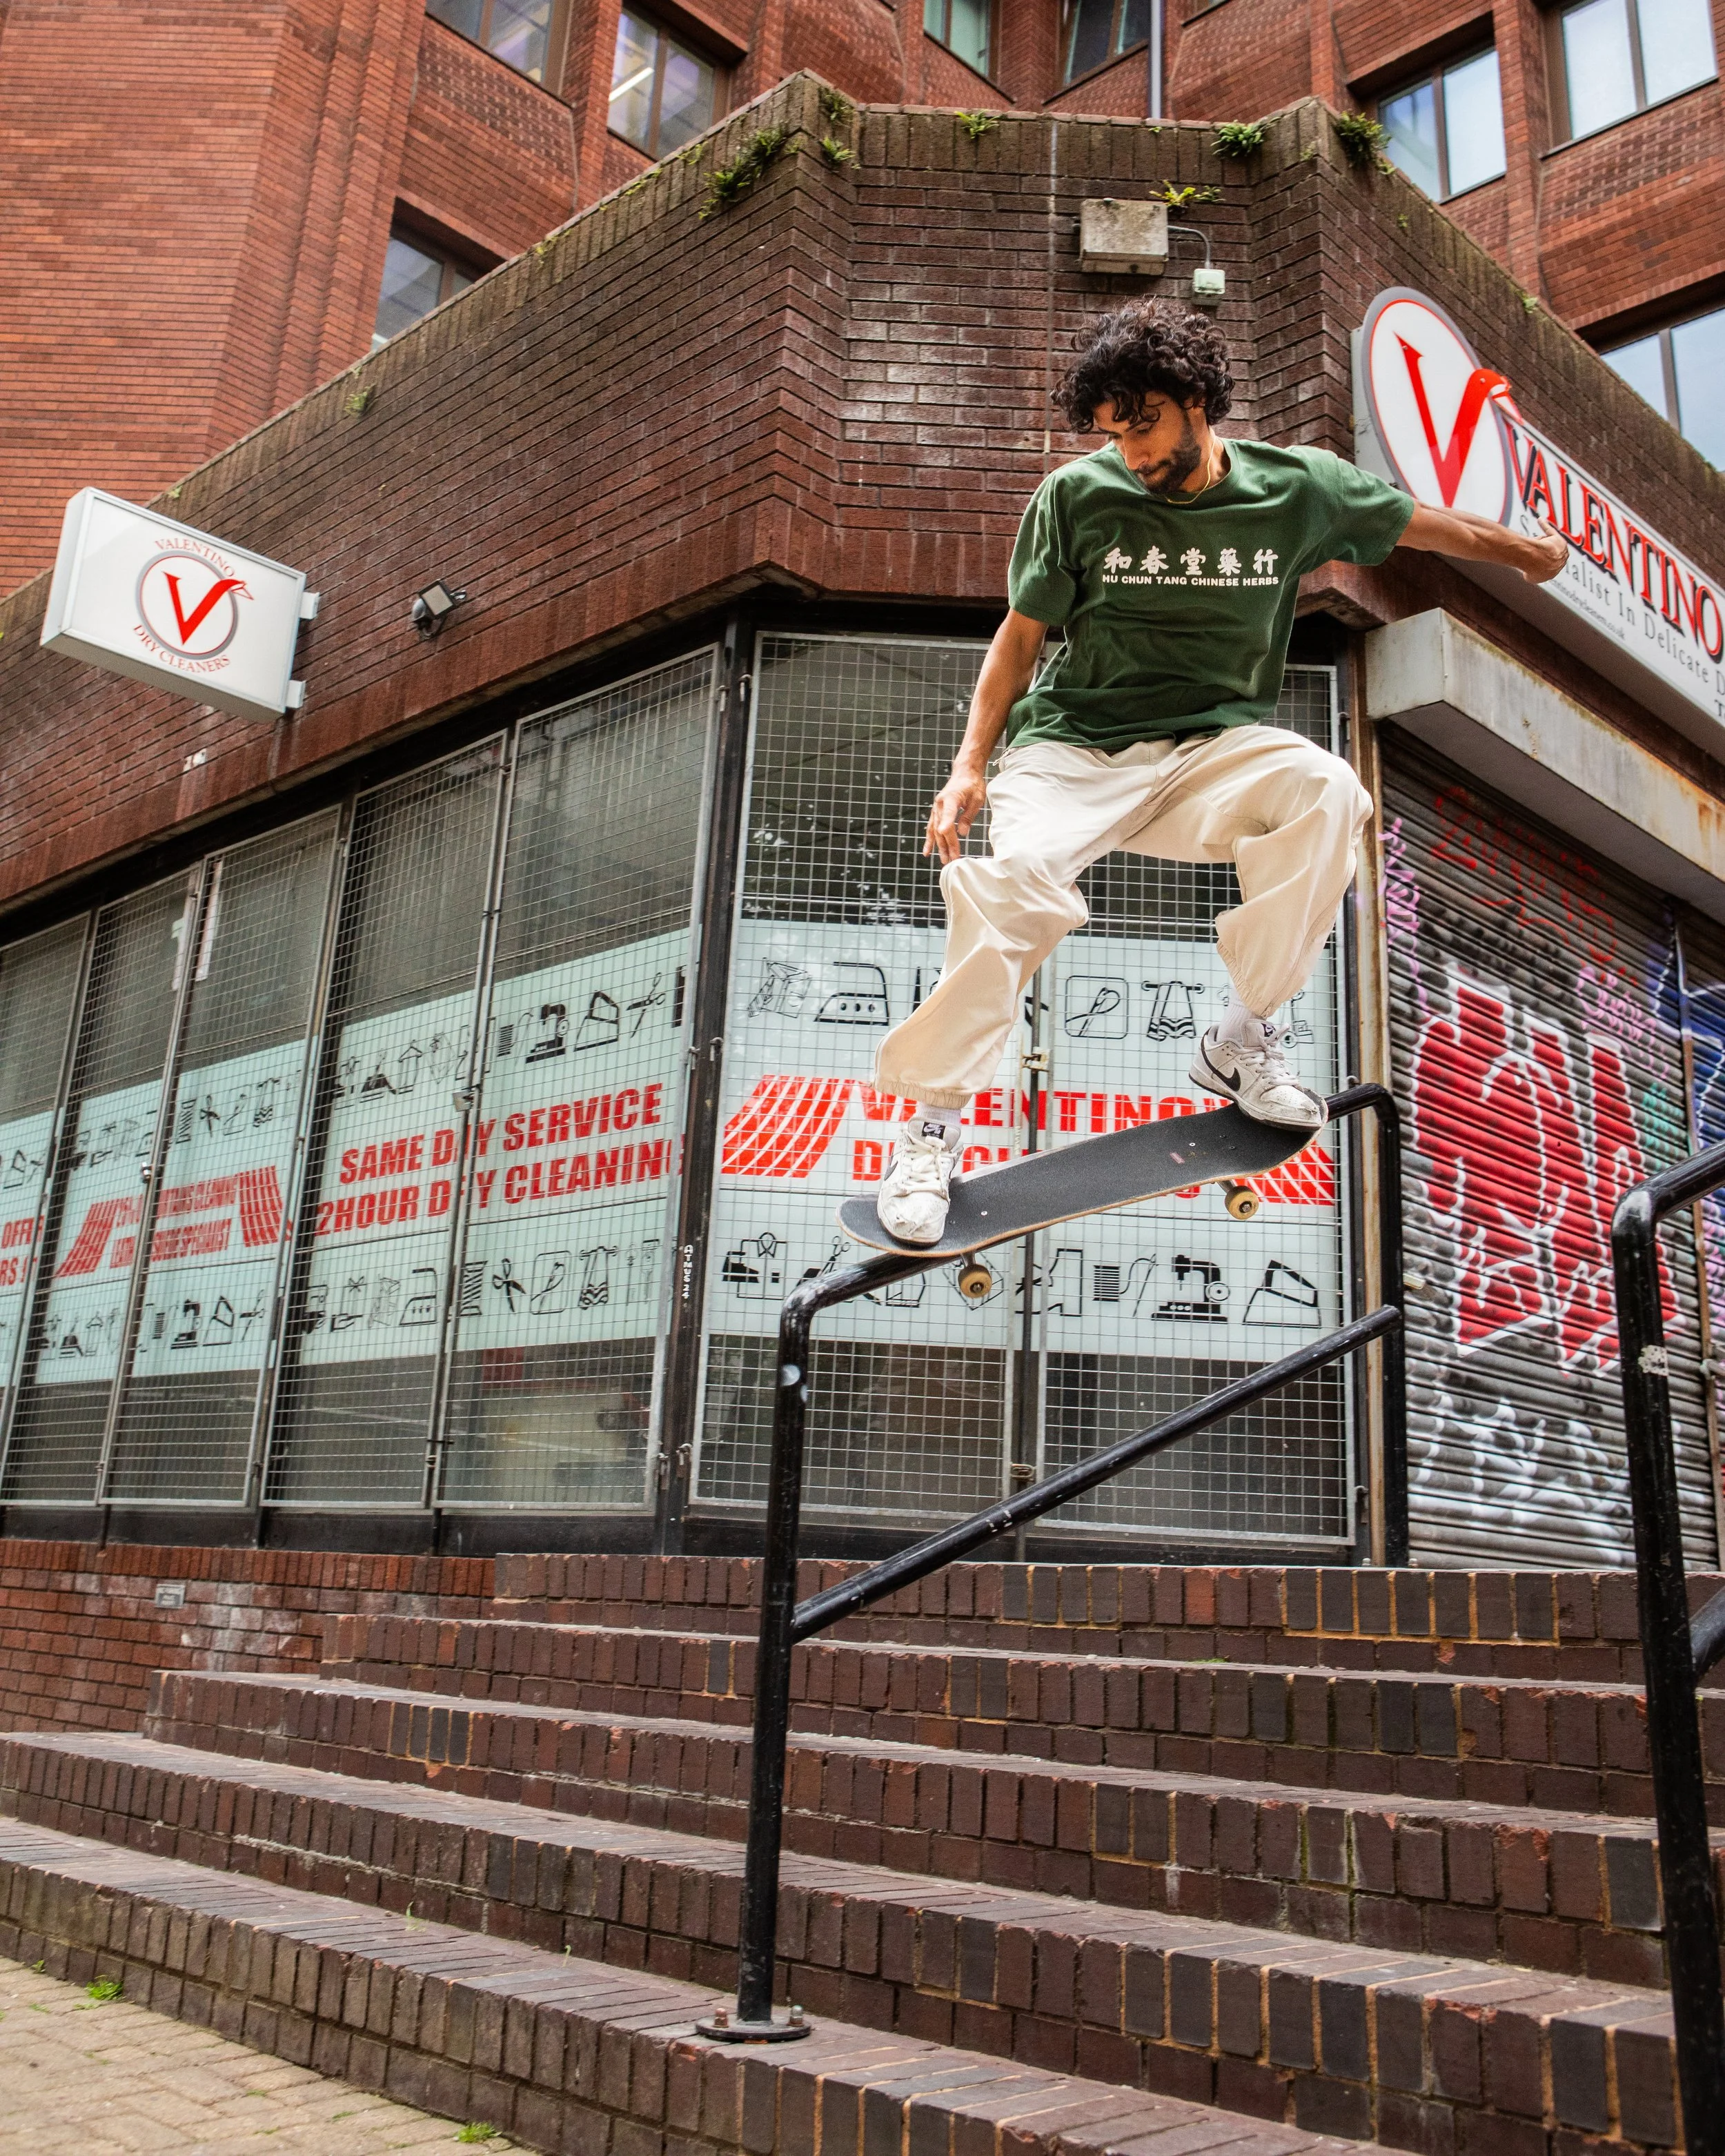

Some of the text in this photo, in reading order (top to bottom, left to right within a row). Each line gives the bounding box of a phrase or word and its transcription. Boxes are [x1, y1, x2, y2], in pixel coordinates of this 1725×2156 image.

[154, 537, 235, 577] VALENTINO
[1505, 418, 1724, 661] VALENTINO
[1102, 575, 1279, 586] HU CHUN TANG CHINESE HERBS
[1520, 514, 1610, 606] Sialist
[1619, 591, 1636, 626] In
[1644, 612, 1709, 683] Delicate
[132, 624, 231, 673] DRY CLEANERS
[339, 1134, 426, 1185] SAME
[502, 1082, 663, 1153] SERVICE
[427, 1169, 497, 1218] DY
